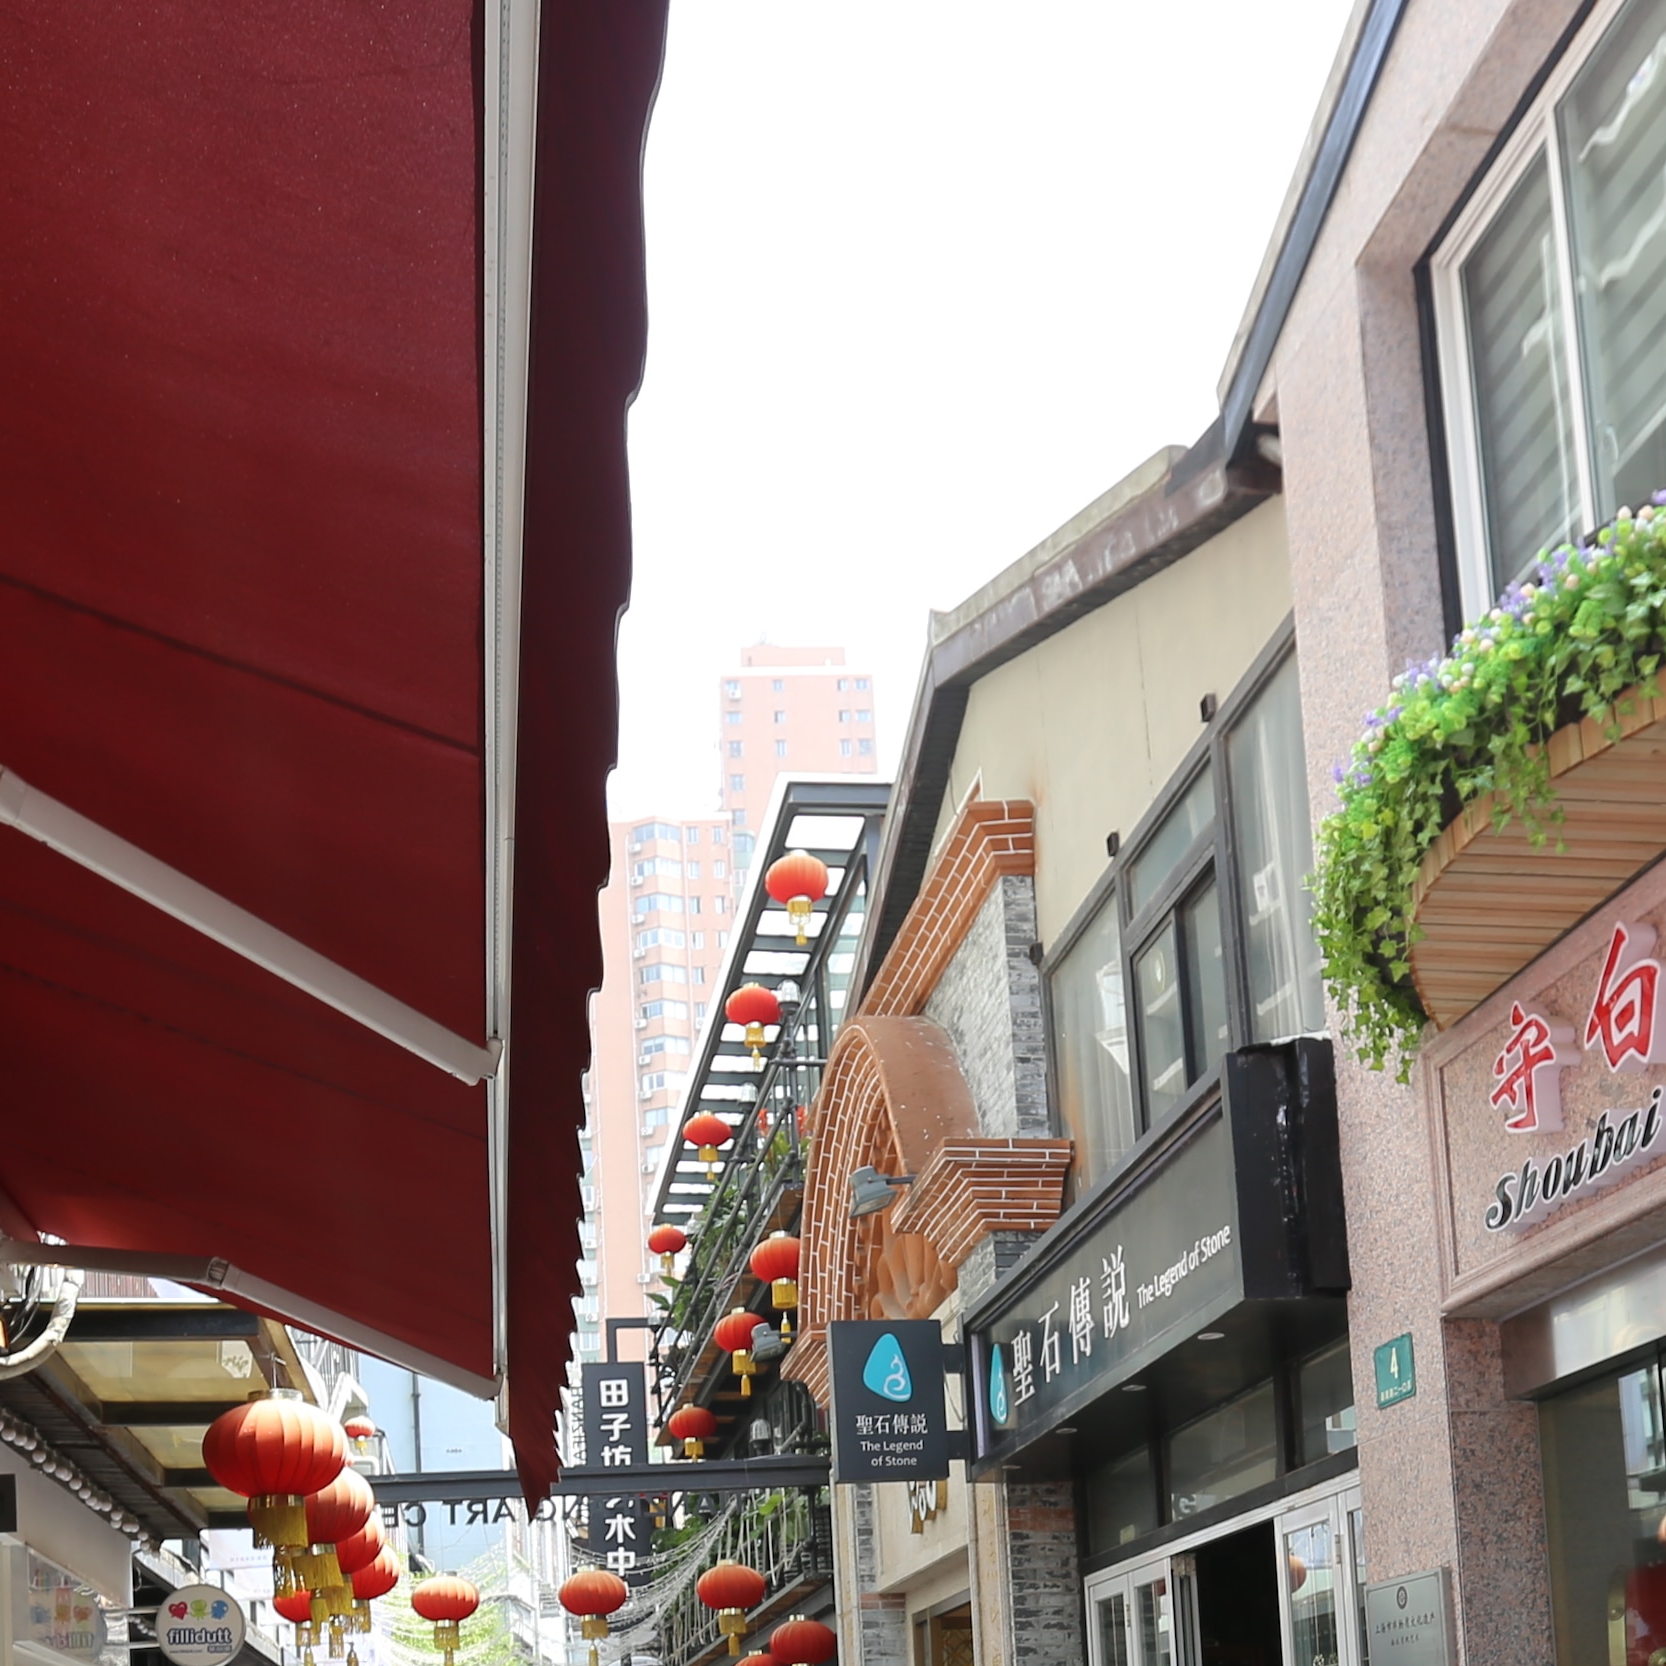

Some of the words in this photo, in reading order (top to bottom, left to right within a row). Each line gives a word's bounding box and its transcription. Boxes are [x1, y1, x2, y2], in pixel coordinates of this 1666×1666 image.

[1485, 1088, 1664, 1232] Shoubai
[1136, 1283, 1155, 1309] The
[1154, 1250, 1188, 1297] Legend
[1188, 1241, 1200, 1270] of
[1200, 1225, 1231, 1262] Stone
[1390, 1346, 1399, 1380] 4
[860, 1440, 881, 1452] The
[883, 1439, 924, 1453] Legend
[871, 1456, 883, 1466] of
[885, 1455, 918, 1467] Stone
[599, 1378, 637, 1596] 田子坊术中
[167, 1627, 233, 1645] fillidutt
